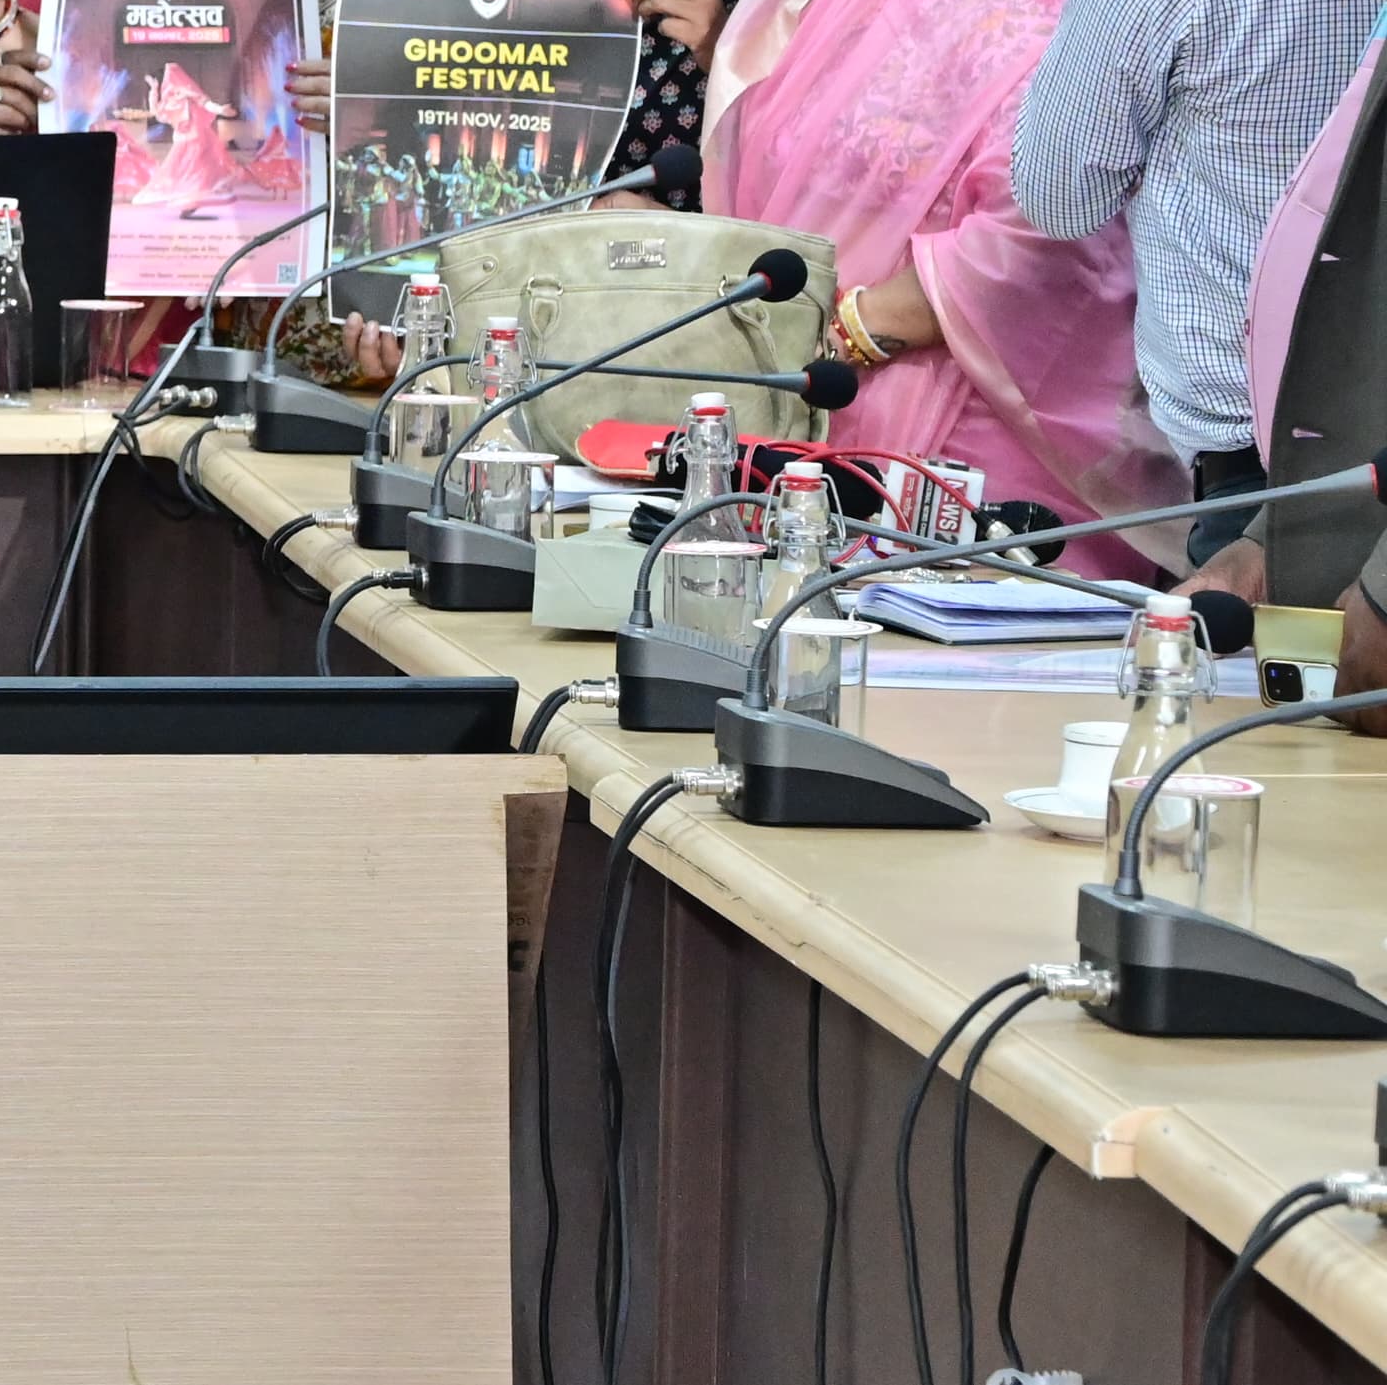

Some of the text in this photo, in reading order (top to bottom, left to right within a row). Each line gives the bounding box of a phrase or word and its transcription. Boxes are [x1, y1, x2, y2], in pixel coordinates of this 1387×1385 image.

[126, 2, 224, 28] महोत्सव
[404, 38, 568, 66] GHOOMAR
[415, 67, 555, 93] FESTIVAL
[417, 109, 551, 132] 19TH NOV, 2025
